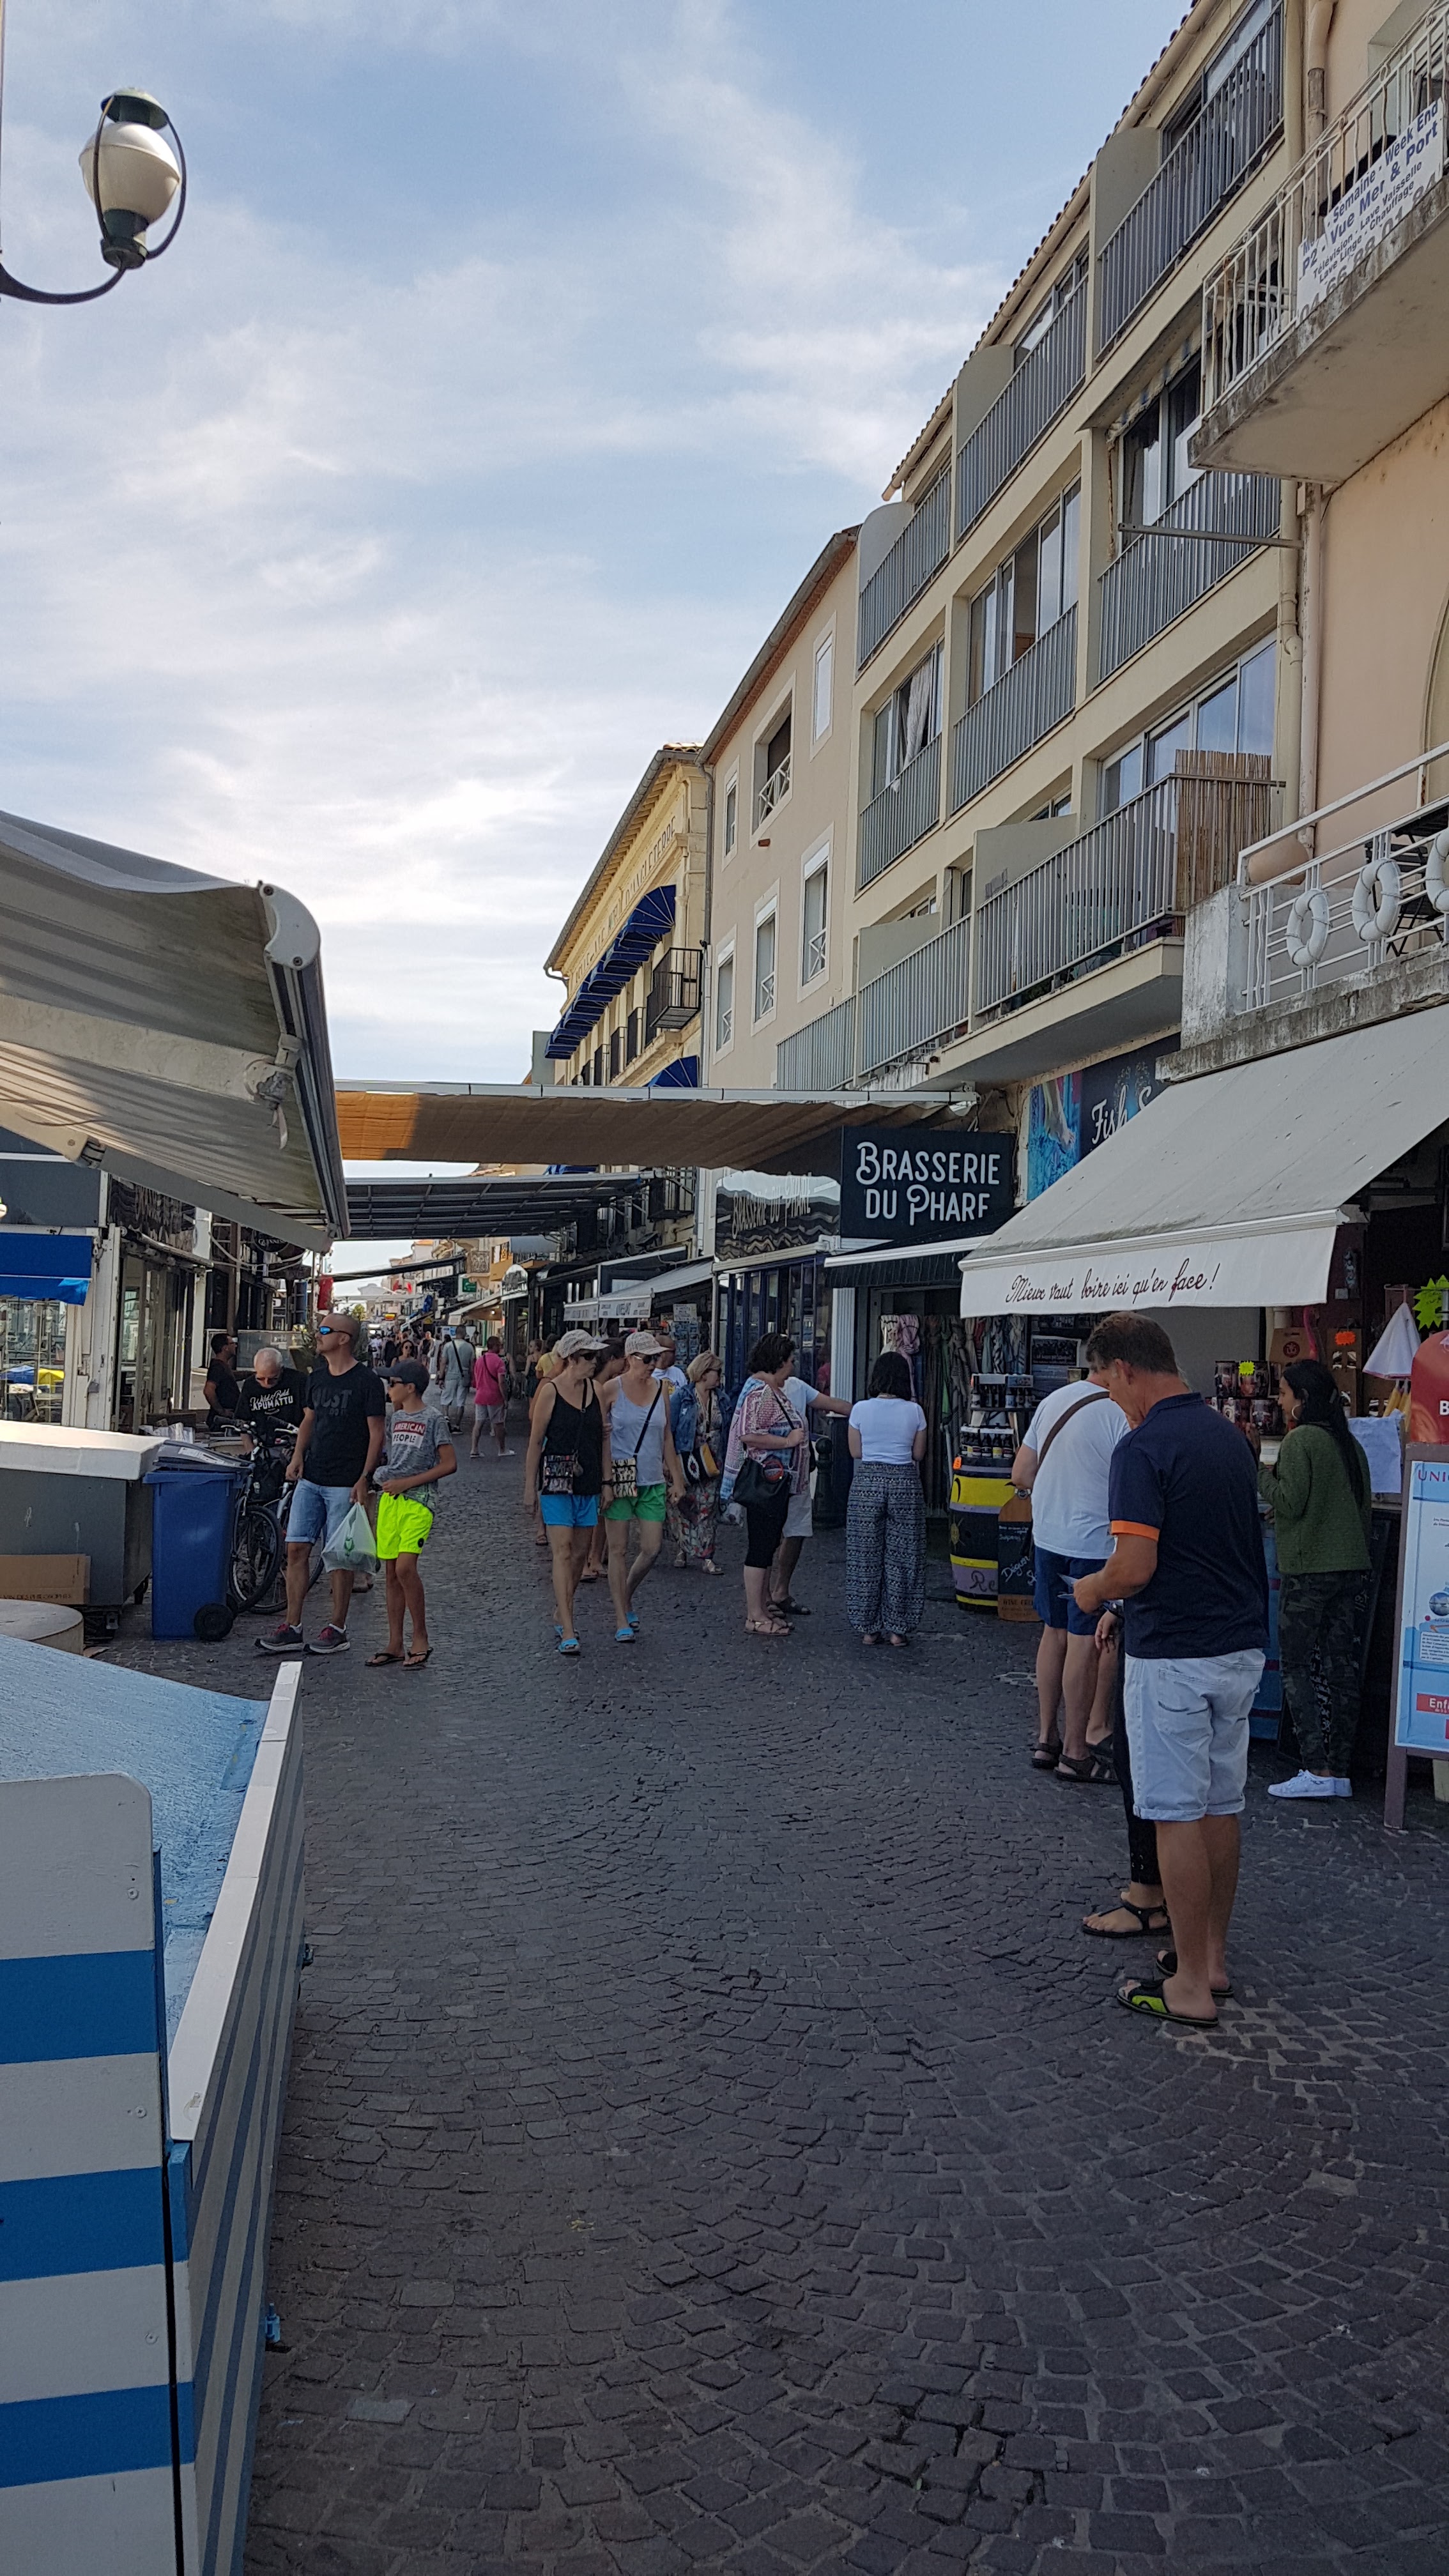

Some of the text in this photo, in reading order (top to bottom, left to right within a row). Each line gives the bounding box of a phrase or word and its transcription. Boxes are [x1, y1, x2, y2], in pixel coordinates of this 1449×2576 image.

[1333, 169, 1377, 222] Semaine
[1384, 125, 1413, 167] Week
[1417, 102, 1438, 133] End
[1302, 120, 1438, 277] P2 Vue Mer & Port
[1313, 161, 1422, 280] Télévision Lave Vaisselle
[1319, 181, 1414, 285] Lave Linge Chauffage
[856, 1142, 1000, 1186] BRASSERIE
[866, 1188, 897, 1220] DU
[1005, 1274, 1046, 1303] Mieux
[1049, 1277, 1074, 1300] vaut
[1080, 1268, 1110, 1299] boire
[1112, 1273, 1130, 1296] ici
[393, 1434, 417, 1443] PEOPLE
[394, 1422, 425, 1434] AMERICAN
[1418, 1469, 1449, 1482] UNI
[1429, 1698, 1449, 1710] Enf
